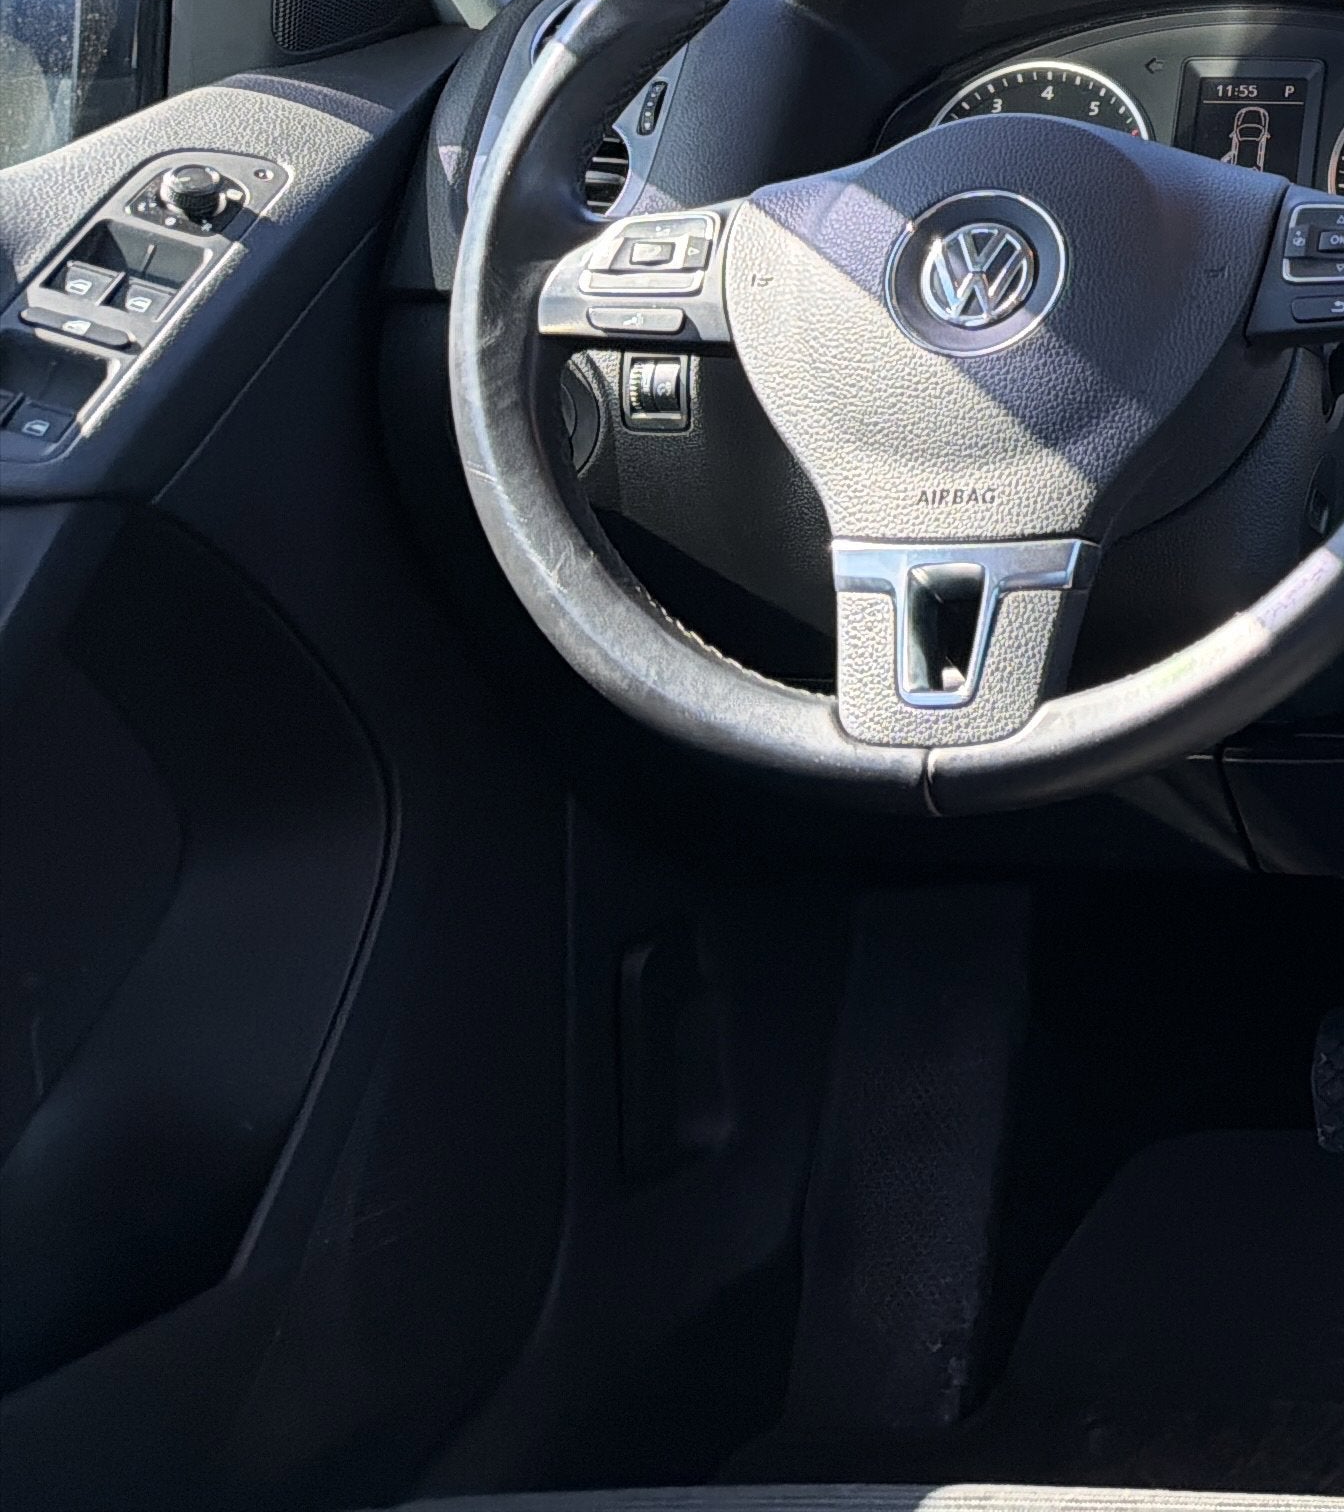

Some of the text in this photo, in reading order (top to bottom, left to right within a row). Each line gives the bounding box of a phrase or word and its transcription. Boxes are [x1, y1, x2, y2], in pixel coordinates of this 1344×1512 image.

[1041, 86, 1054, 100] 4
[1216, 84, 1259, 98] 11:55
[1284, 85, 1295, 98] P
[991, 98, 1003, 113] 3
[1088, 101, 1100, 116] 5
[916, 489, 996, 505] AIRBAG
